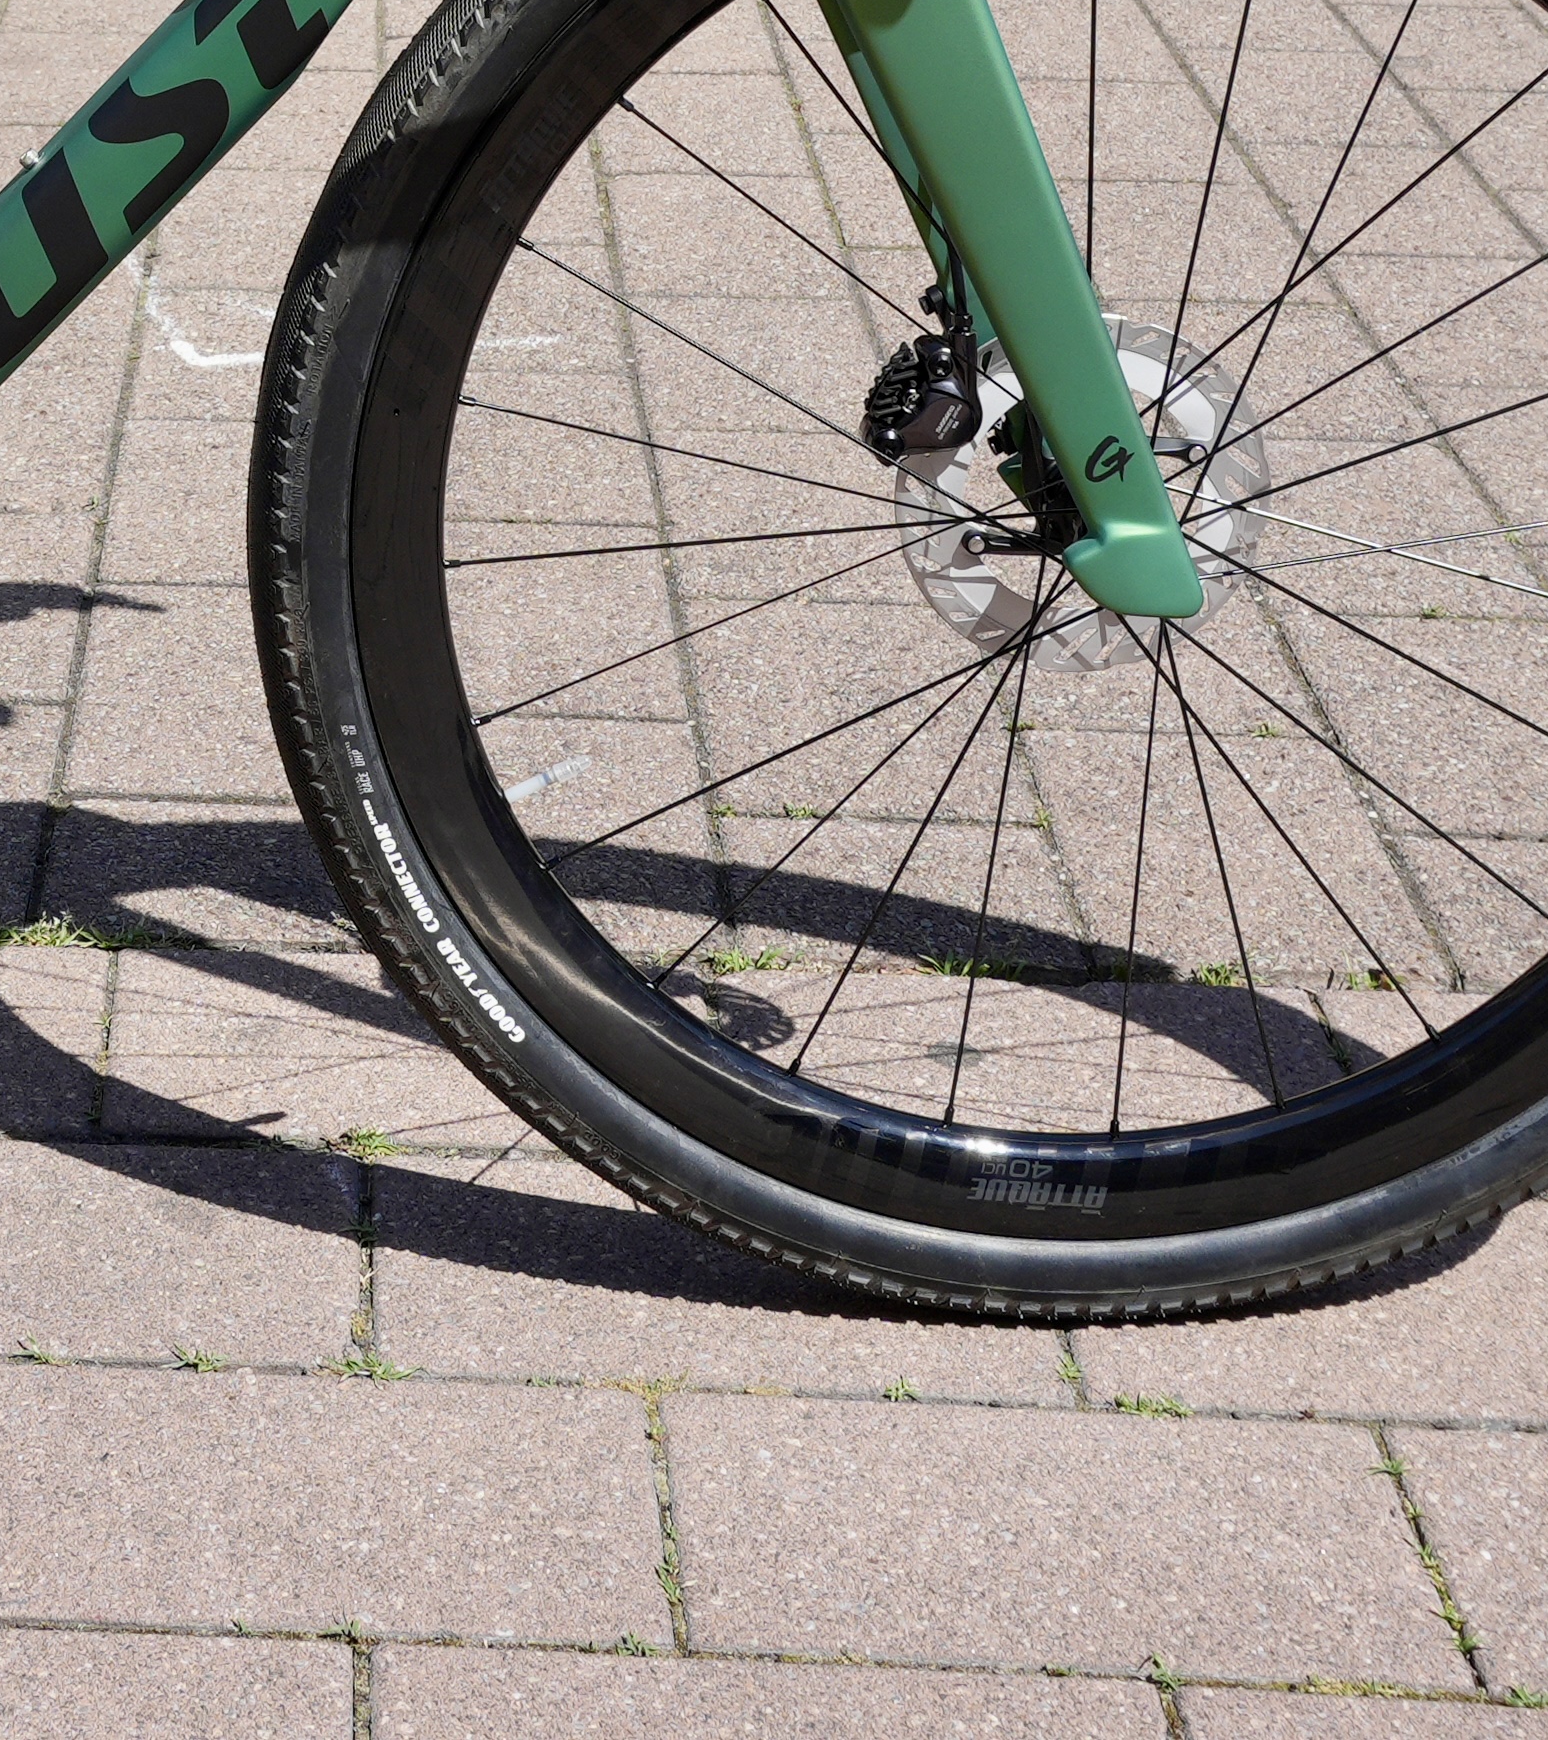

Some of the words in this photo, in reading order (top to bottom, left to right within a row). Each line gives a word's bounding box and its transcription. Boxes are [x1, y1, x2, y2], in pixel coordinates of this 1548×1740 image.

[358, 771, 375, 793] RACE
[362, 799, 378, 825] SPEED
[373, 823, 440, 934] CONNECTOR
[436, 938, 525, 1042] GOODYEAR
[981, 1162, 1007, 1175] UCI
[1009, 1160, 1053, 1178] 40
